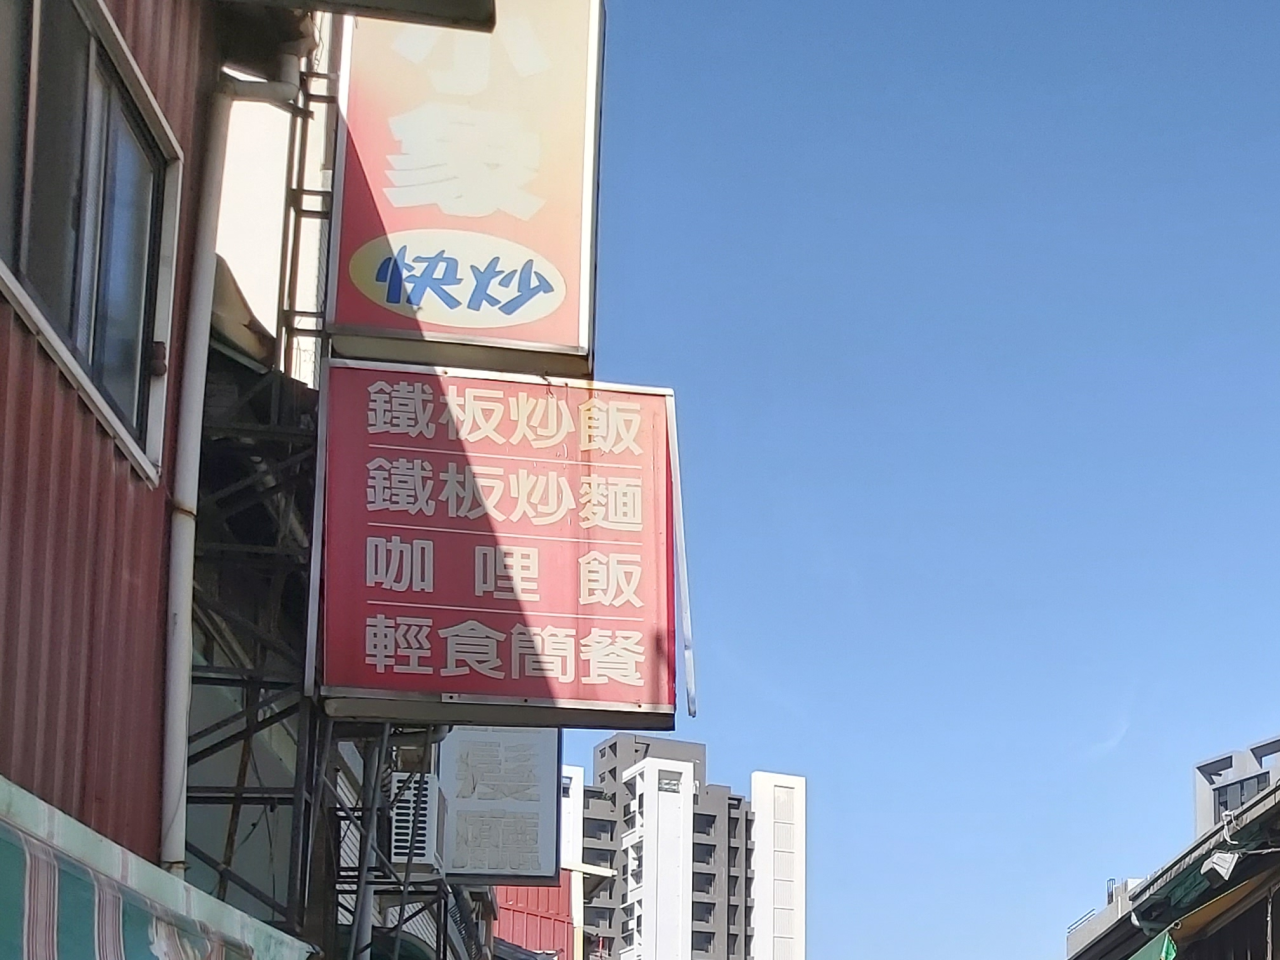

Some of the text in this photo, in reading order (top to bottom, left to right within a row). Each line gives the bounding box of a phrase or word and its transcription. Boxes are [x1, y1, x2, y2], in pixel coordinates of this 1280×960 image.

[375, 244, 555, 316] 快炒
[366, 380, 644, 456] 鐵板炒飯
[366, 457, 644, 532] 鐵板炒麵
[366, 536, 645, 608] 咖哩飯
[365, 613, 646, 687] 輕食簡餐
